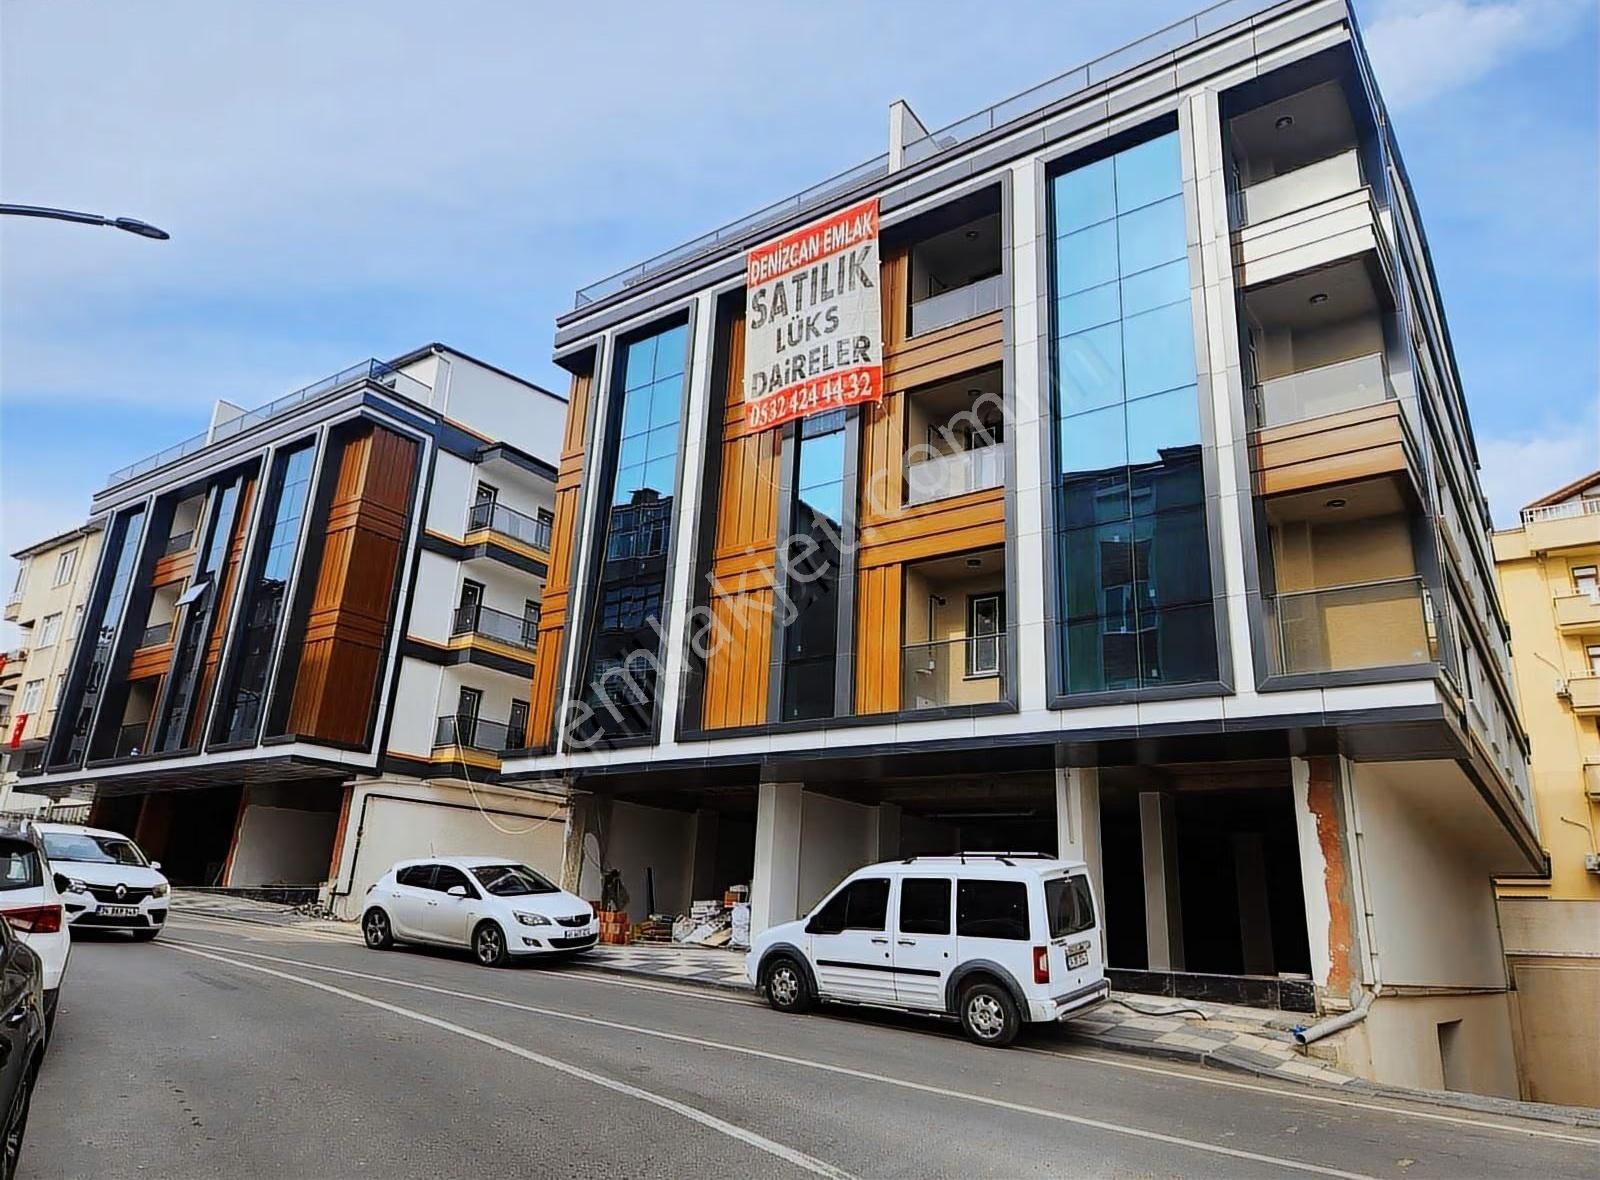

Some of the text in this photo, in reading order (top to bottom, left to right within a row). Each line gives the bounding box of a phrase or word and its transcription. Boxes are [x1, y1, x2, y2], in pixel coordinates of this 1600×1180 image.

[750, 212, 874, 284] DENİZCAN EMLAK
[750, 245, 874, 330] SATILIK
[775, 305, 840, 354] LÜKS
[790, 385, 817, 413] 424
[822, 376, 844, 404] 44
[848, 371, 873, 400] 32
